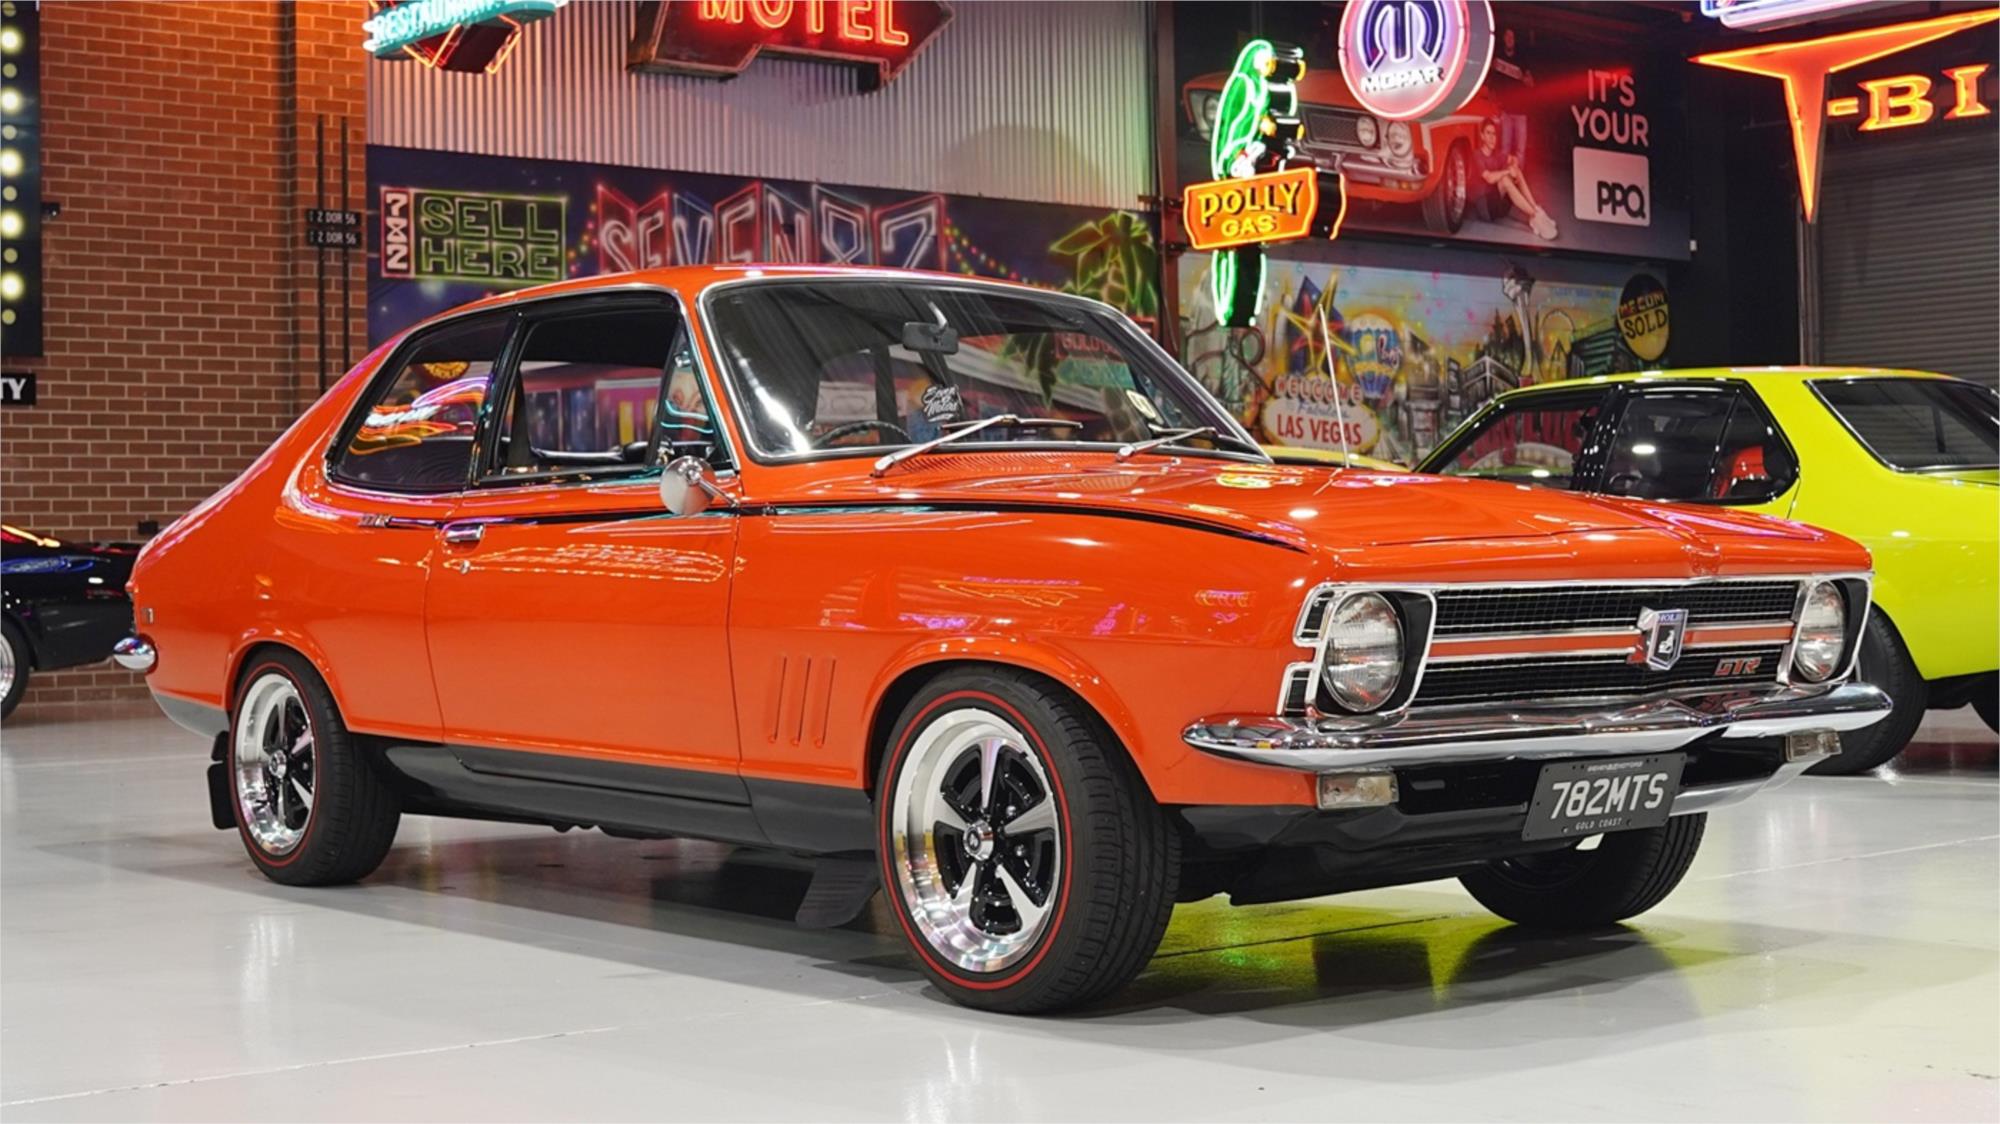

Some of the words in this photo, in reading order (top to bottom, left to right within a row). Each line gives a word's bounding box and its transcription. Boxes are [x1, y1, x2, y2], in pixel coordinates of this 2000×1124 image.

[1361, 66, 1440, 93] MOPAR
[1588, 69, 1636, 107] IT'S
[1571, 104, 1649, 147] YOUR
[1198, 180, 1302, 226] POLLY
[1597, 180, 1646, 219] PPQ
[420, 196, 559, 242] SELL
[1221, 214, 1276, 237] GAS
[420, 237, 559, 279] HERE
[1623, 309, 1667, 340] SOLD
[1276, 376, 1363, 404] WELCOME
[1276, 413, 1304, 439] LAS
[1309, 419, 1361, 446] VEGAS
[1713, 656, 1762, 676] GTR
[1551, 772, 1669, 820] 782MTS
[1575, 820, 1595, 831] GOLD
[1598, 817, 1622, 829] COAST
